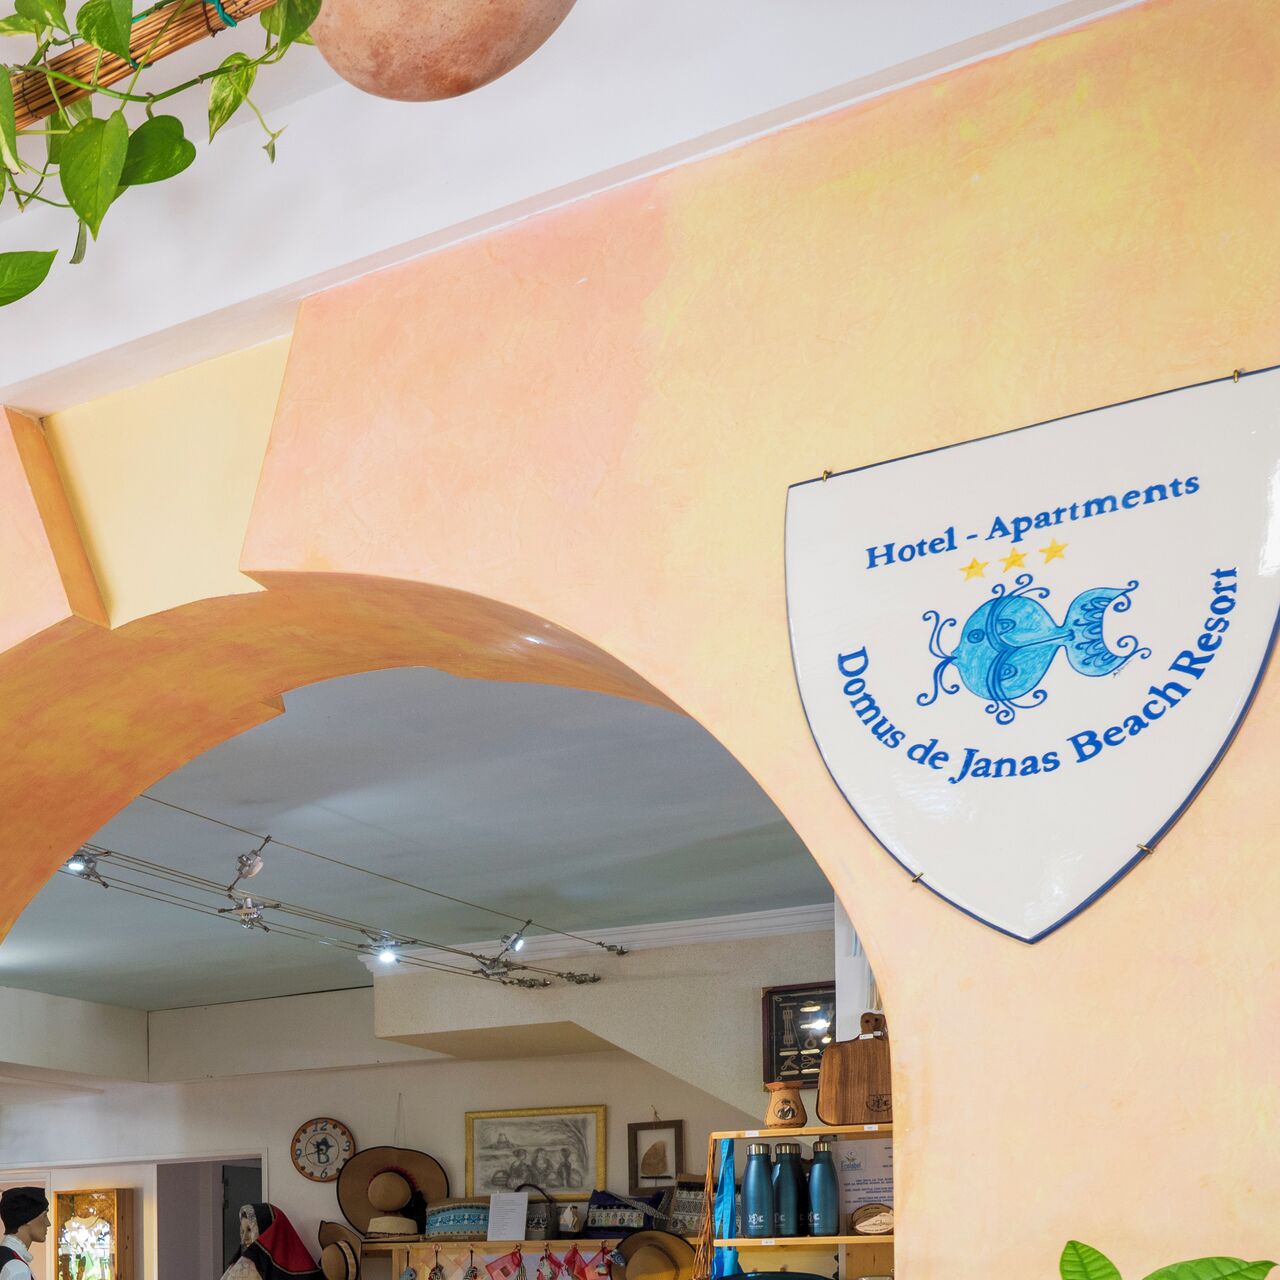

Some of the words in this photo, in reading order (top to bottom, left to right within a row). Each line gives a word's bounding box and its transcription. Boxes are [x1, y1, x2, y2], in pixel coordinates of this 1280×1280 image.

[865, 526, 958, 569] Hotel
[985, 474, 1201, 543] Apartments
[836, 645, 907, 749] Domus
[906, 738, 950, 770] de
[947, 747, 1061, 784] Janas
[1066, 681, 1192, 764] Beach
[1167, 566, 1238, 681] Resort
[312, 1120, 329, 1133] 12
[342, 1140, 351, 1152] 3
[320, 1167, 329, 1180] 6
